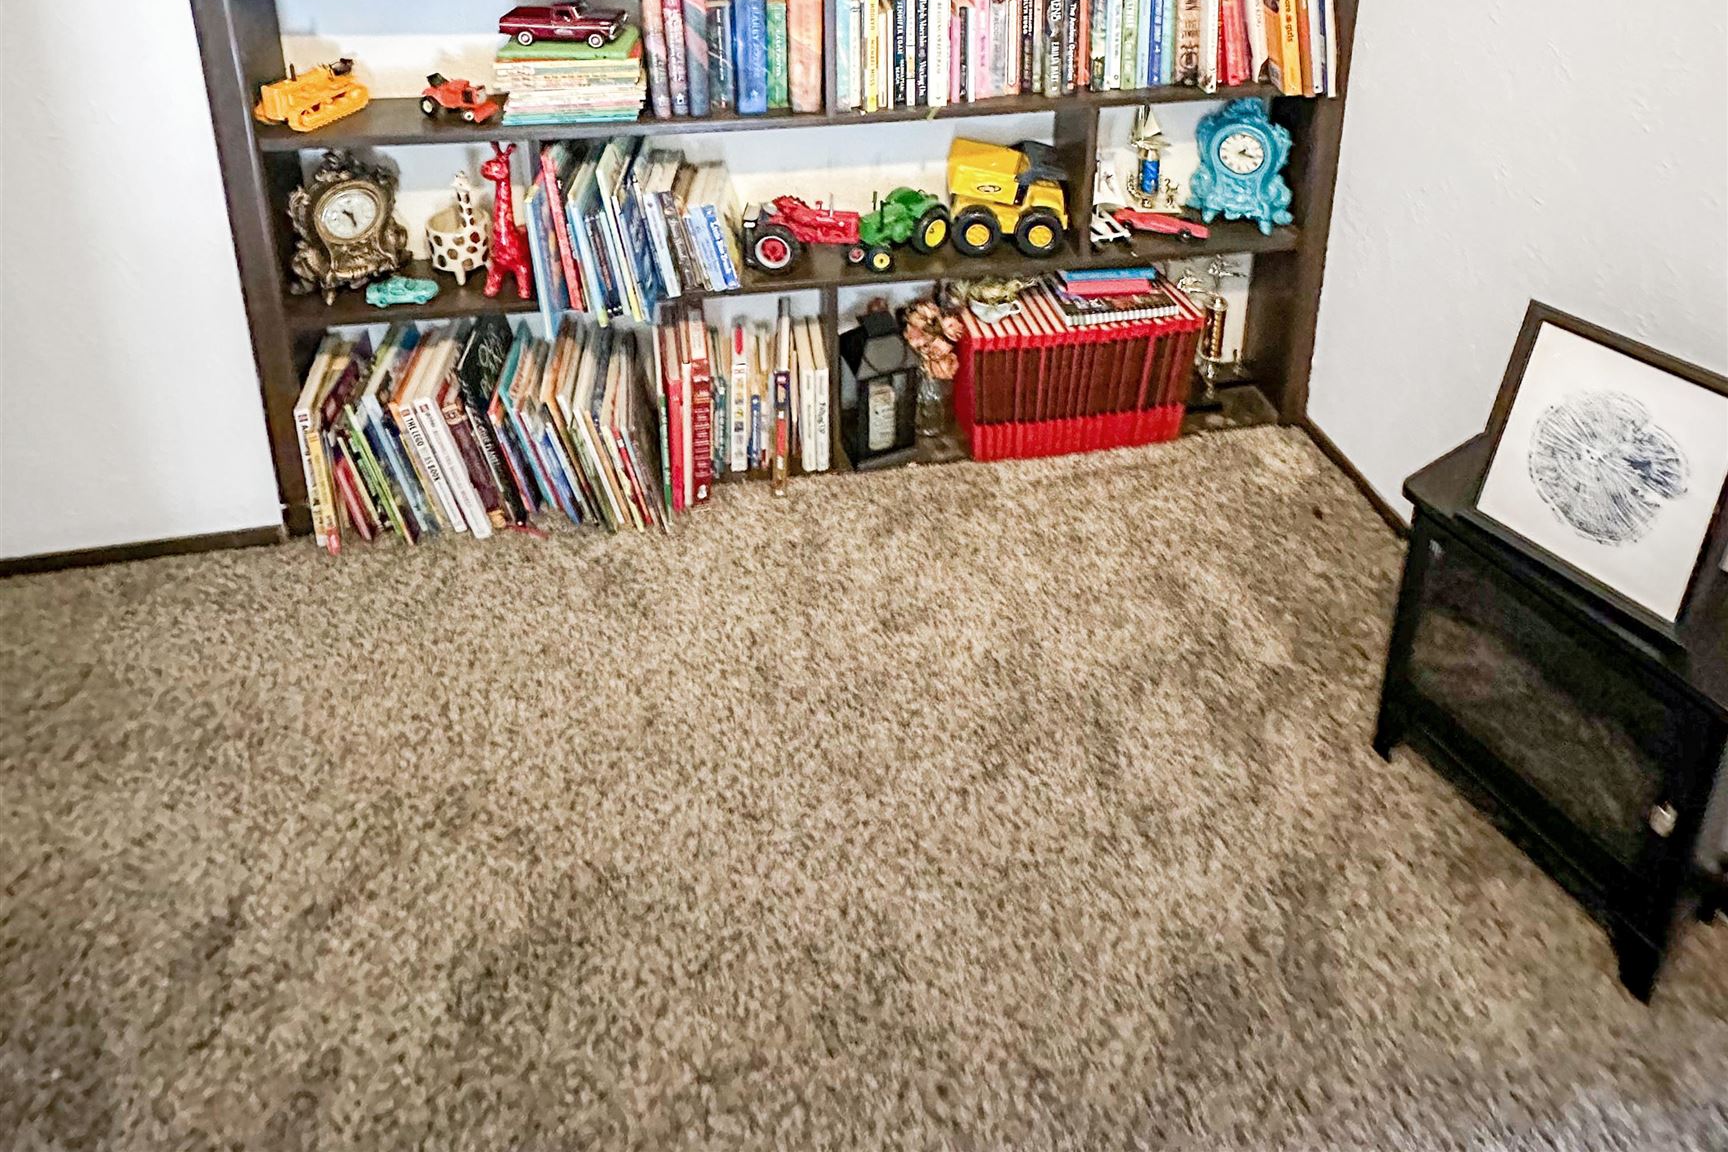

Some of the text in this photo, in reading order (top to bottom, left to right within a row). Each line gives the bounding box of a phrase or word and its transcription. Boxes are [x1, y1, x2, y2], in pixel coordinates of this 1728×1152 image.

[1284, 23, 1295, 43] girls
[1067, 44, 1075, 81] Generation
[411, 430, 425, 448] LEGO
[427, 464, 441, 483] BOOK
